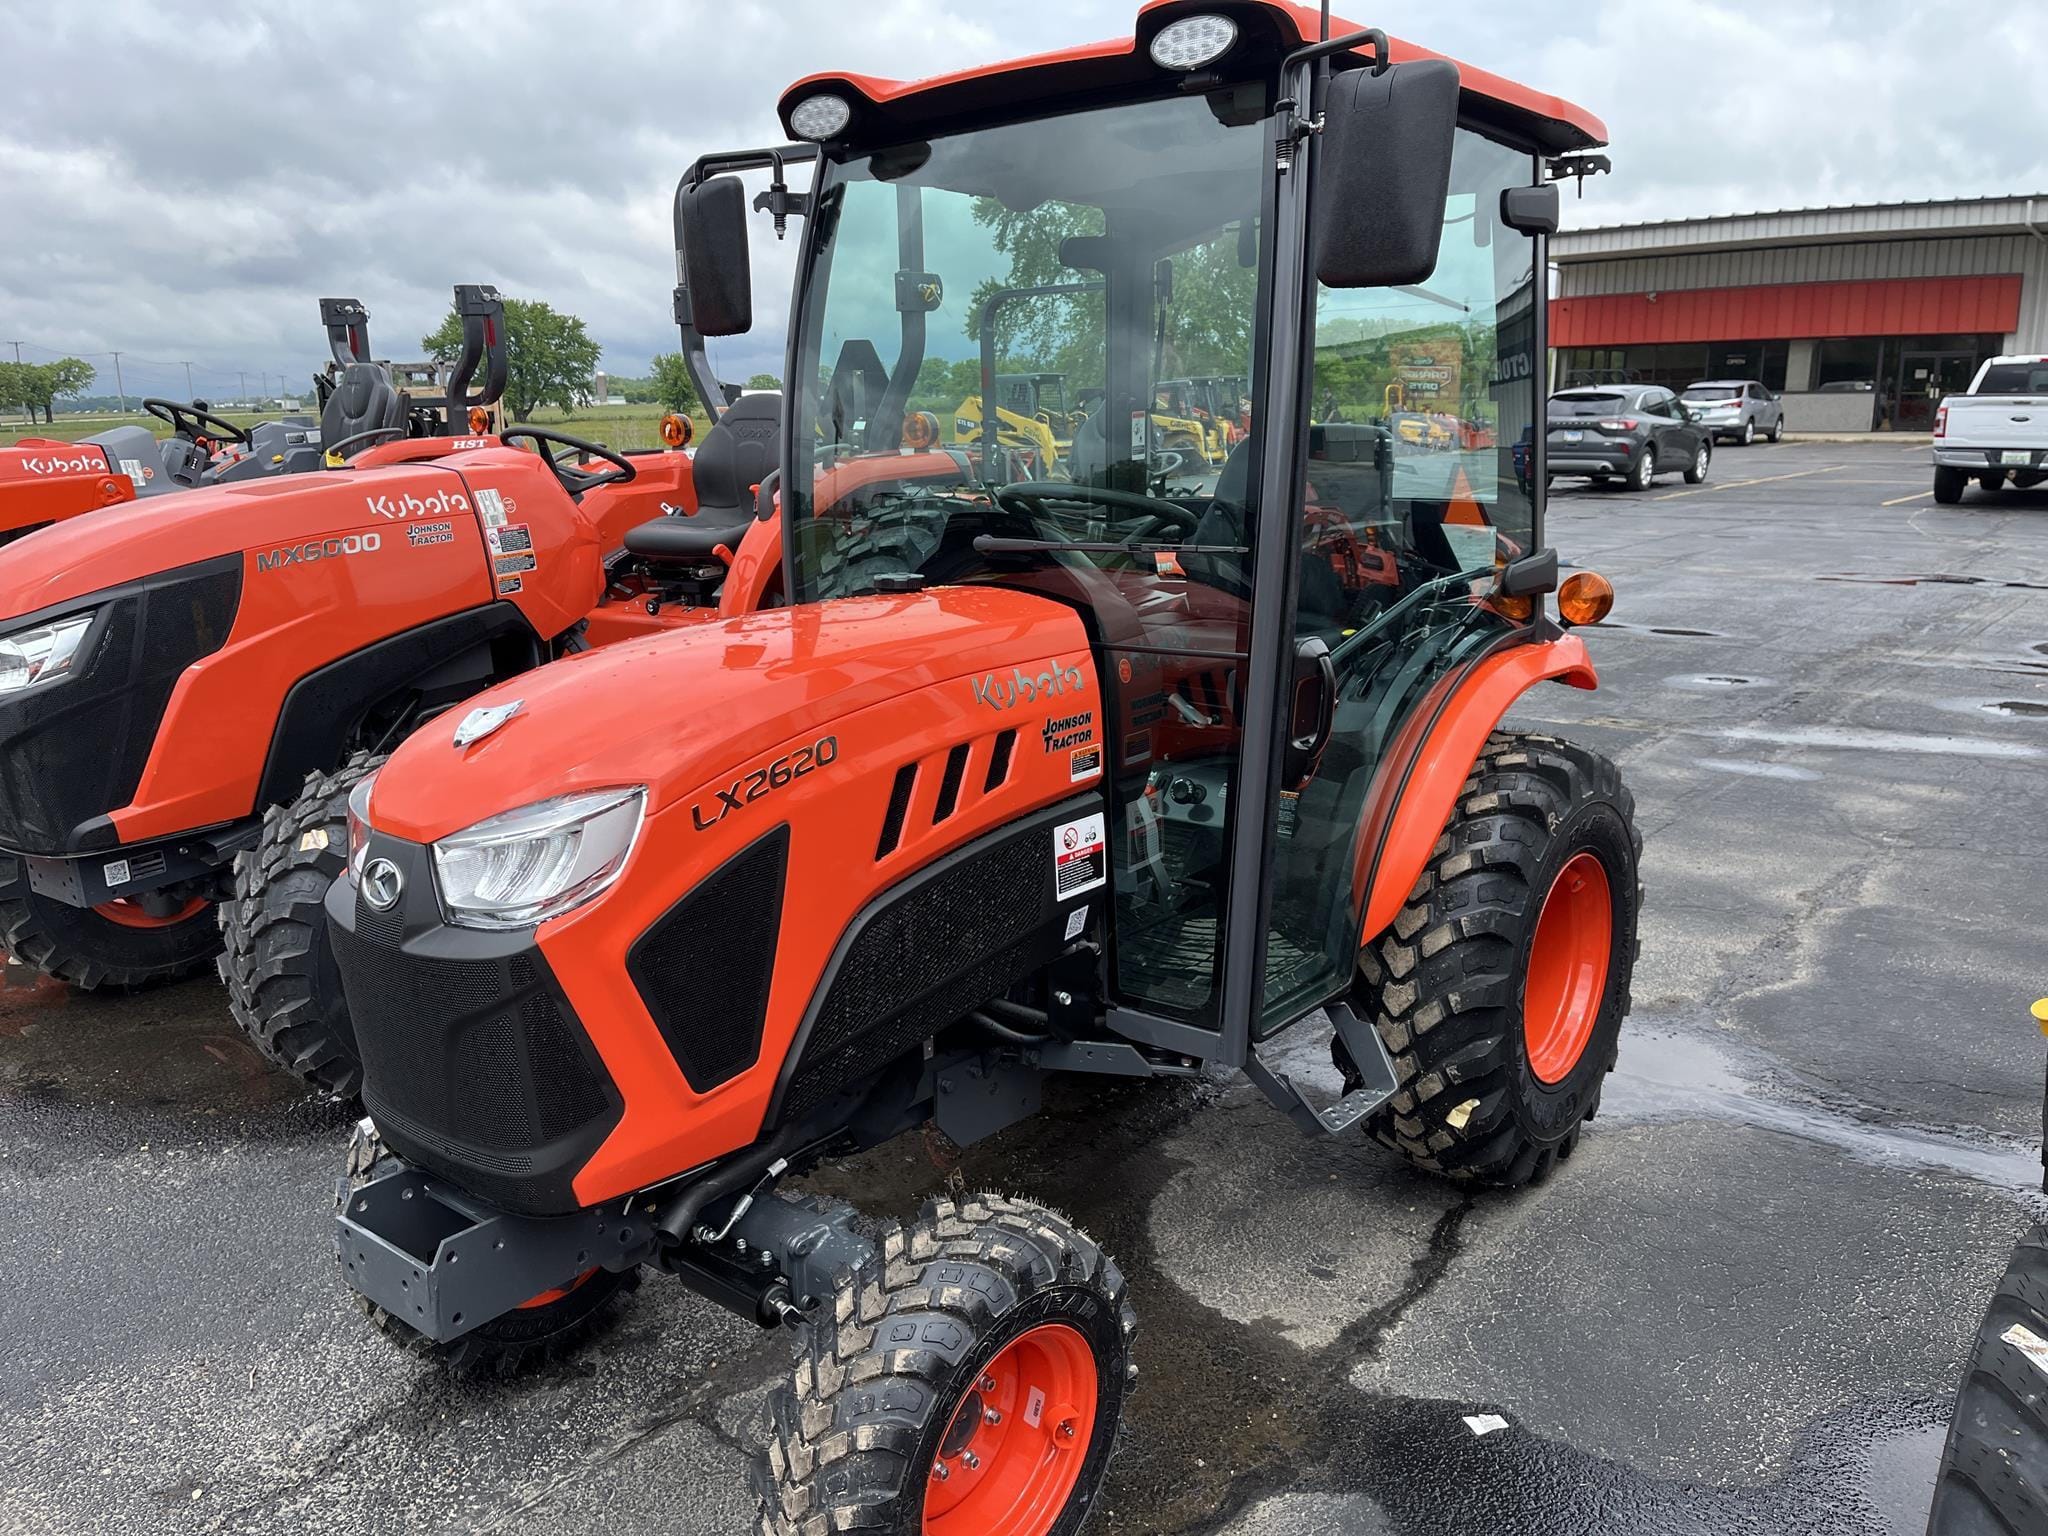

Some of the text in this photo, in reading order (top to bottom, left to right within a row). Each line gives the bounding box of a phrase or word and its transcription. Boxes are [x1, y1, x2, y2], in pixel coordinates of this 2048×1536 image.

[452, 439, 487, 449] HST
[22, 455, 105, 474] Kubota
[367, 490, 469, 518] Kubota
[407, 522, 451, 535] JOHNSON
[409, 533, 453, 546] TRACTOR
[256, 533, 381, 572] MX6000
[971, 659, 1083, 711] Kubota
[1042, 711, 1092, 735] JOHNSON
[1042, 729, 1092, 753] TRACTOR
[691, 736, 838, 831] LX2620
